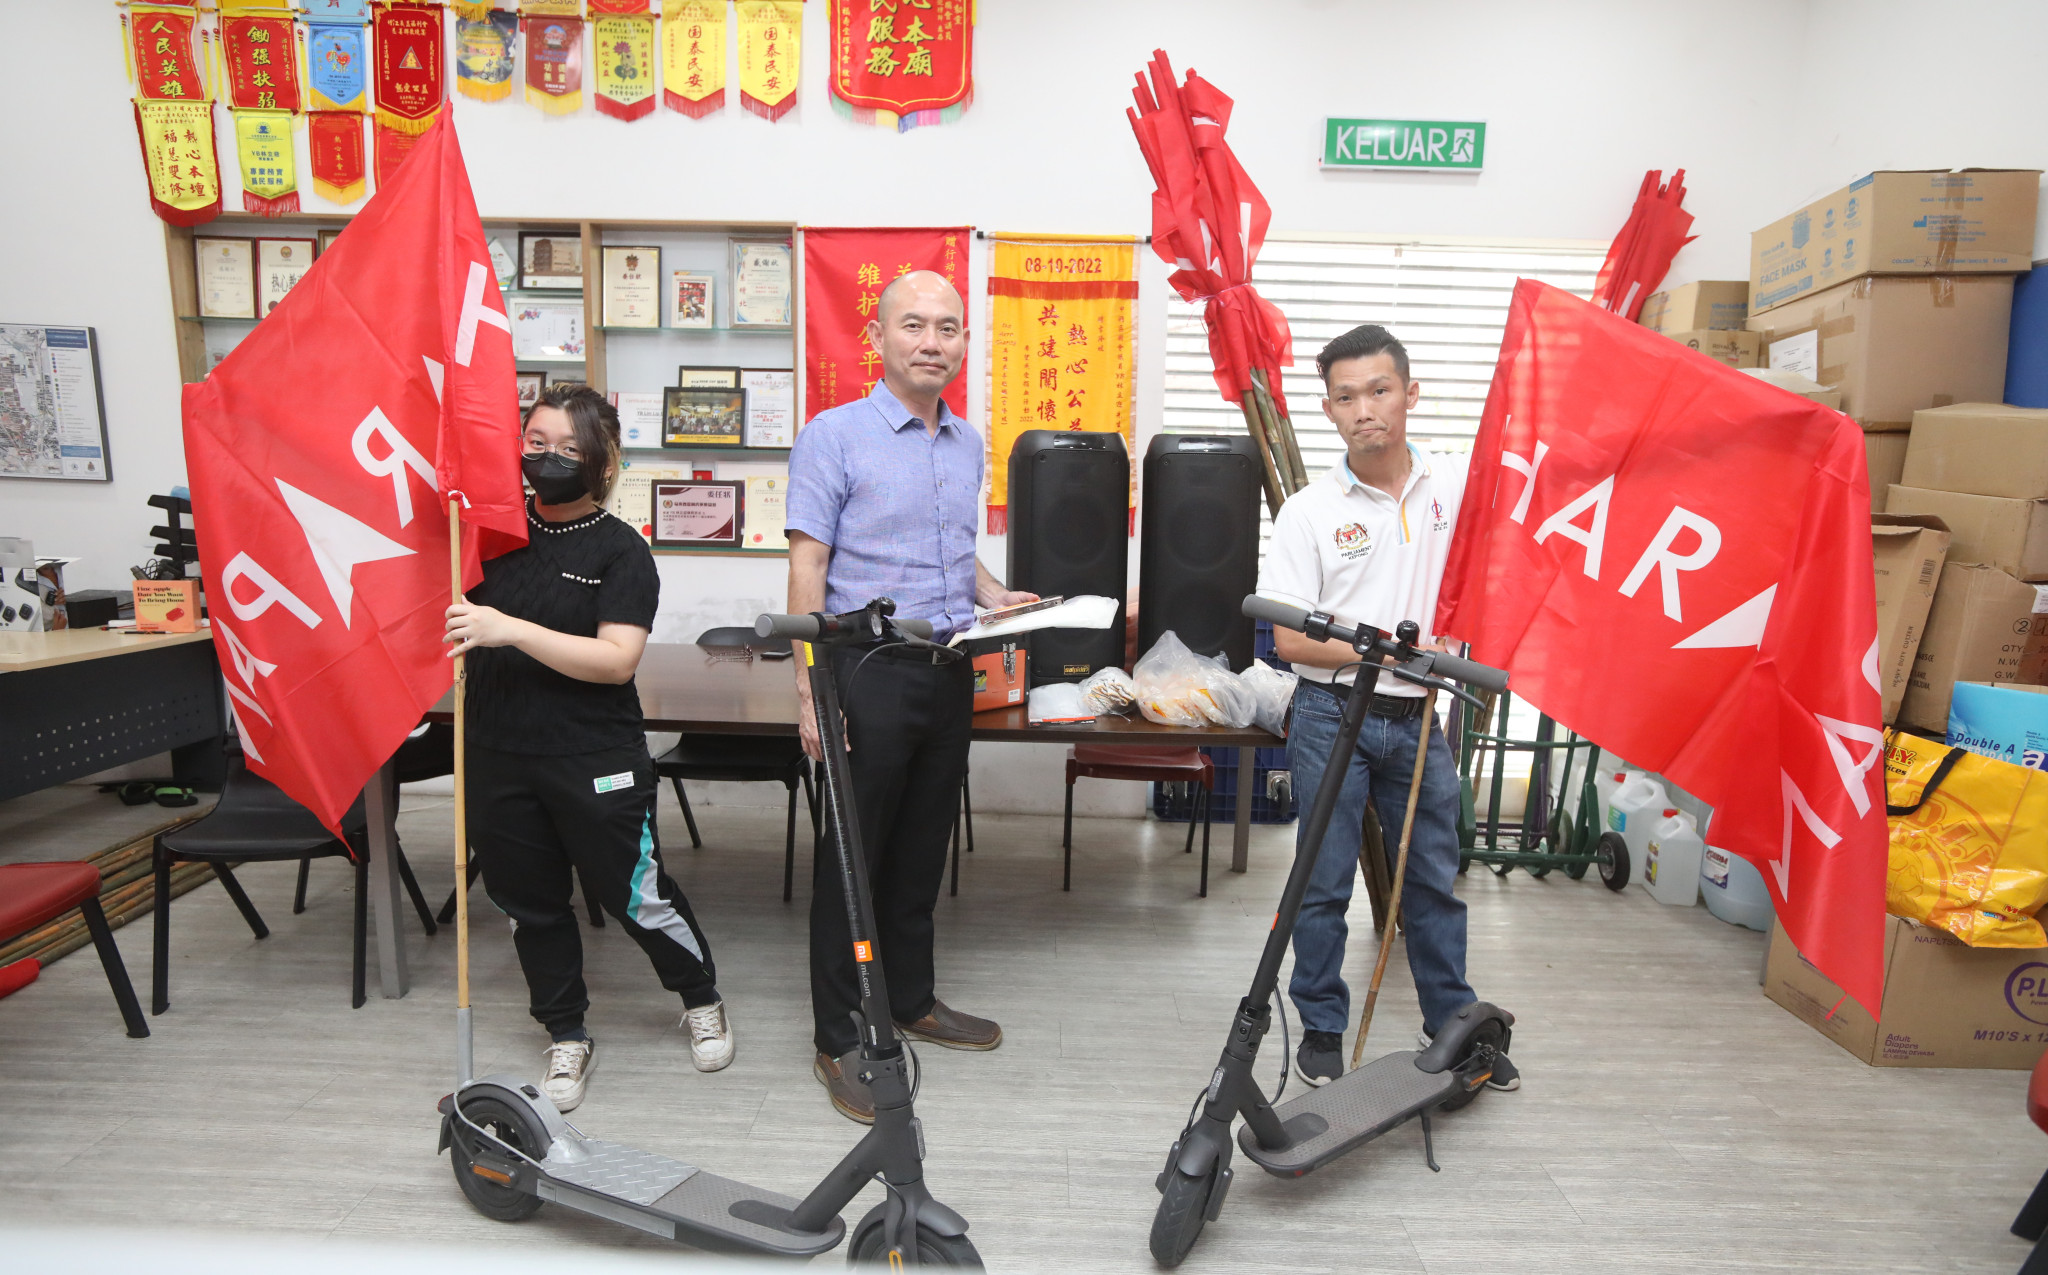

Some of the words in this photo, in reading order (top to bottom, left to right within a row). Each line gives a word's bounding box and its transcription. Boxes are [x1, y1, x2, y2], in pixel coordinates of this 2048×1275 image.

[150, 20, 186, 98] 人民英雄
[684, 25, 704, 87] 国泰民安
[762, 27, 781, 90] 国泰民安
[1336, 126, 1448, 162] KELUAR
[163, 129, 185, 198] 福慧雙修
[1025, 257, 1102, 274] 08-10-2022
[1759, 269, 1780, 288] FACE
[1781, 257, 1808, 278] MASK
[271, 272, 303, 293] 热心教
[1341, 545, 1372, 558] PARLIAMENT
[1955, 732, 2001, 751] Double
[2004, 743, 2015, 755] A
[857, 945, 866, 959] mi
[861, 964, 871, 997] mi.com
[1885, 1039, 1919, 1050] Diapers
[1887, 1033, 1911, 1043] Adult
[1974, 1030, 2019, 1042] M10'S
[1883, 1047, 1907, 1056] LAMPIN
